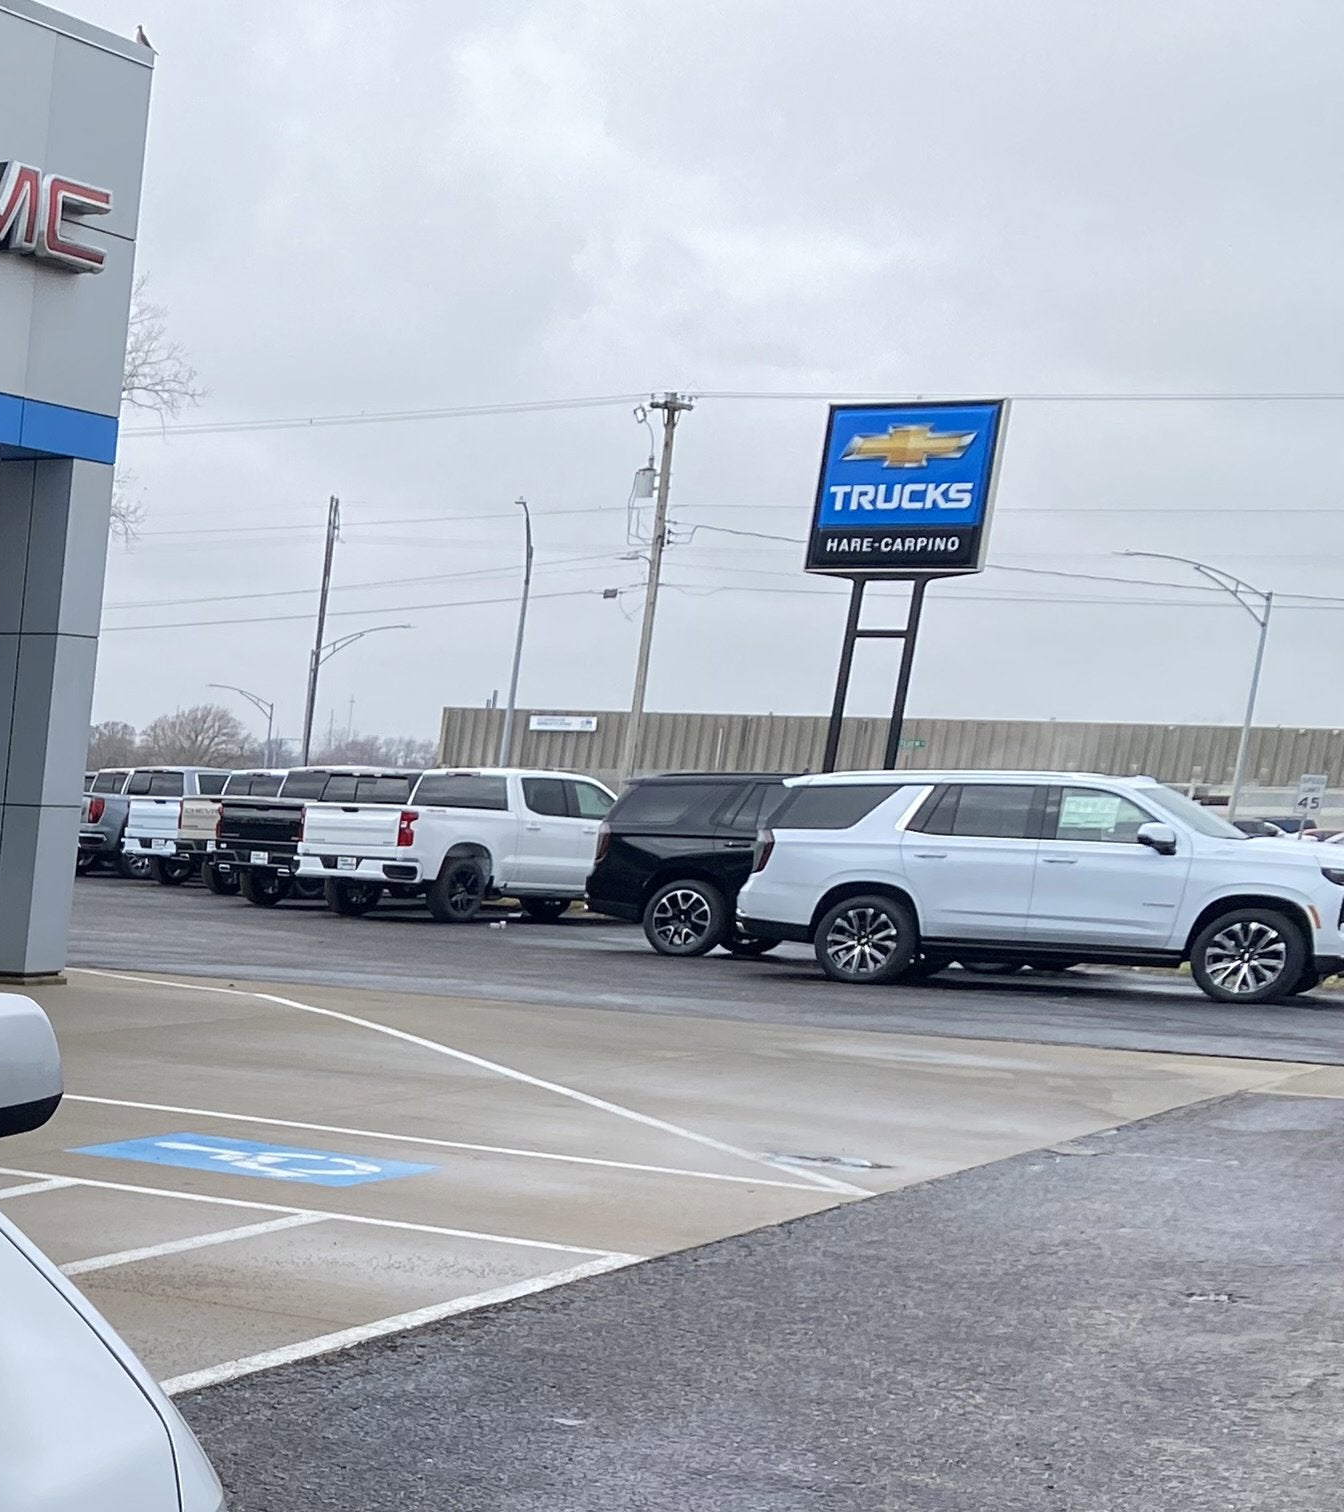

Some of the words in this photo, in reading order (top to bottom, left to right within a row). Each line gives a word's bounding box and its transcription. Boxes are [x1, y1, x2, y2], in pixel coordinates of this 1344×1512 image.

[830, 482, 973, 511] TRUCKS
[826, 537, 960, 552] HARE-CARPINO
[1297, 796, 1320, 809] 45
